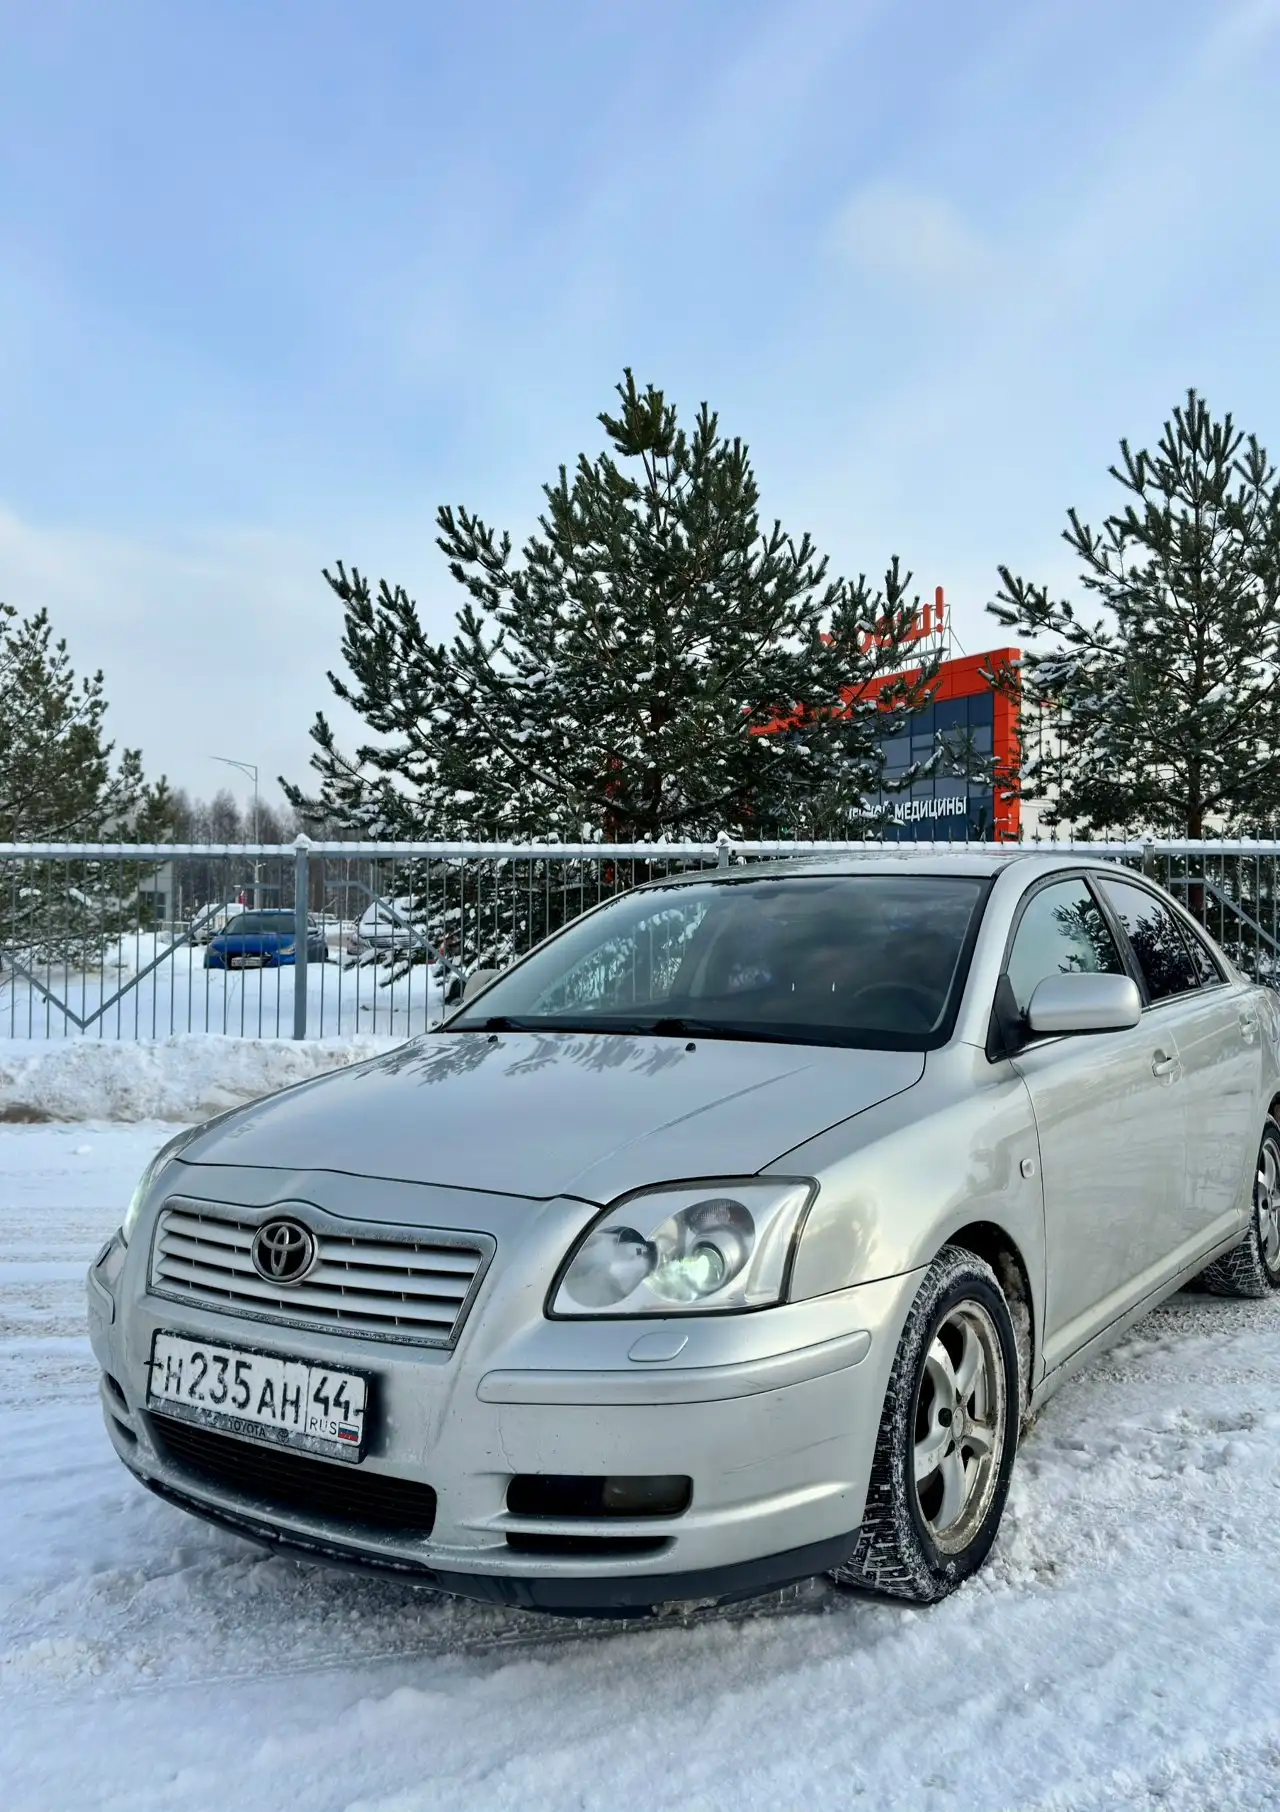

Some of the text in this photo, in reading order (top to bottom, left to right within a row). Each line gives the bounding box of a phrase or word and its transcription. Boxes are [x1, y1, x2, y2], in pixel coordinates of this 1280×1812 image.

[894, 796, 967, 822] МЕДИЦИНЫ
[313, 1375, 351, 1421] 44
[228, 1417, 266, 1438] TOYOTA
[309, 1416, 337, 1435] RUS
